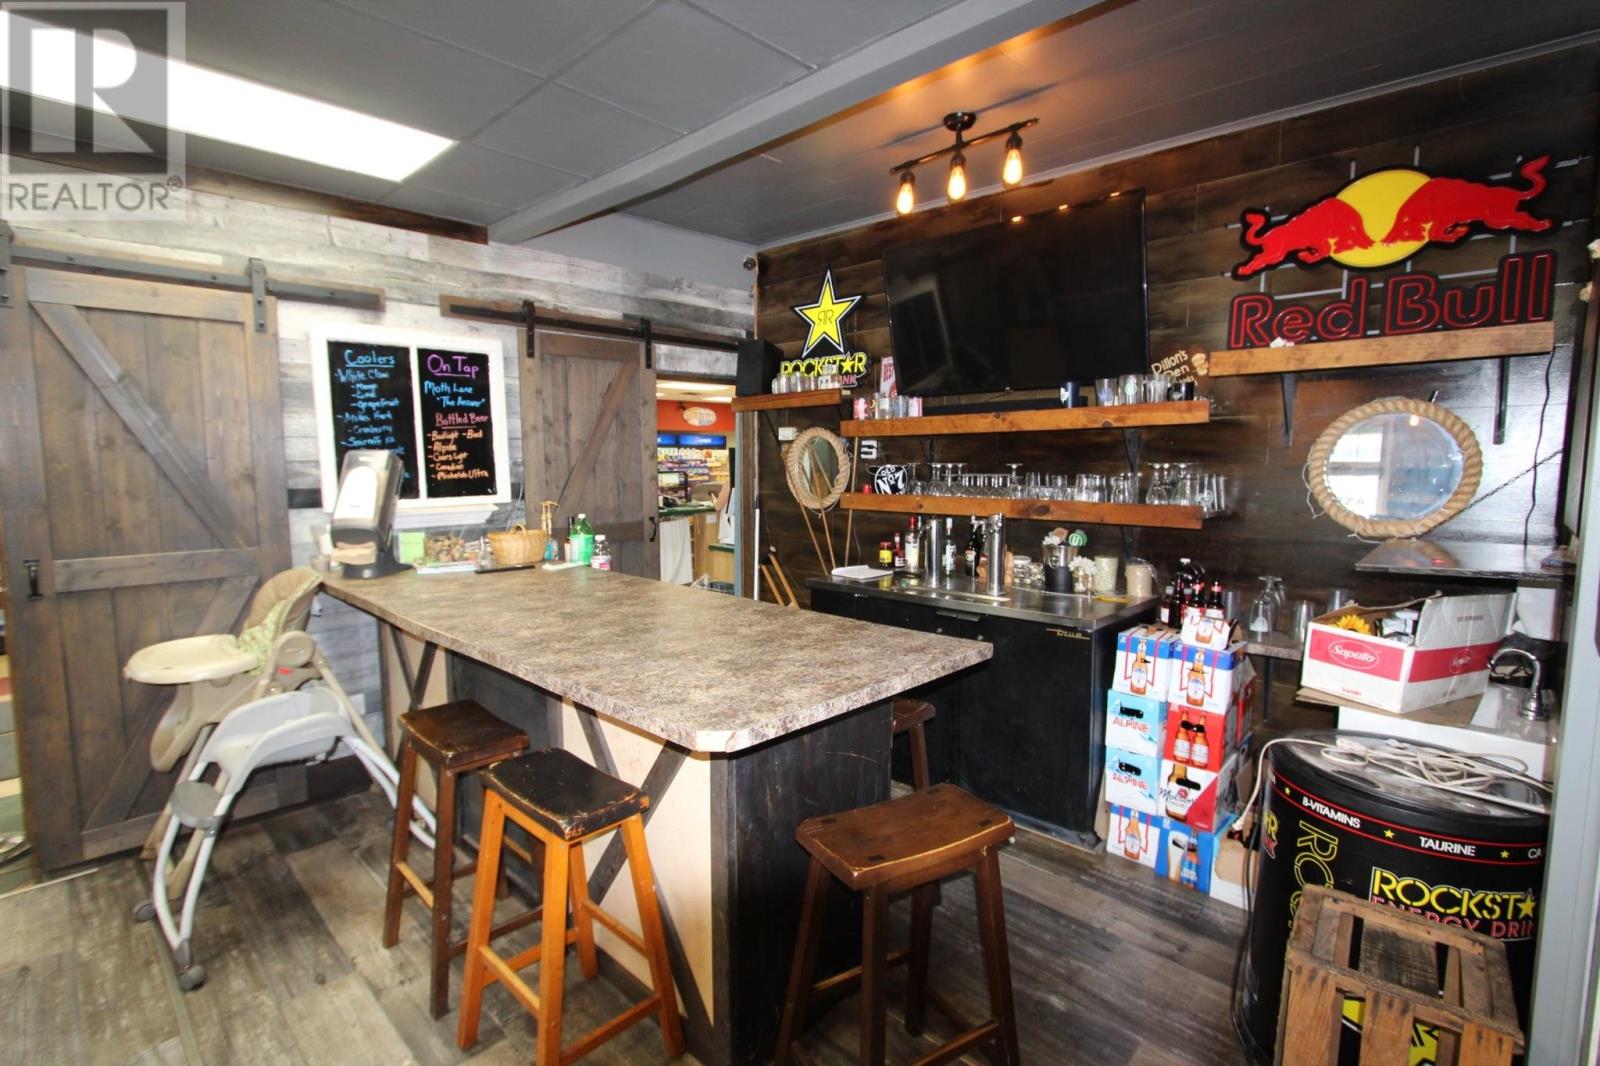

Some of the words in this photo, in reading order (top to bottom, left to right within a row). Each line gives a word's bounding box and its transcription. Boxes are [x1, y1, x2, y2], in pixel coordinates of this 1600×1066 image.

[1230, 276, 1370, 349] Red
[1384, 253, 1551, 336] Bull
[344, 349, 396, 366] Coolers
[427, 354, 451, 374] On
[452, 355, 480, 379] Tap
[453, 383, 473, 394] Lane
[1332, 645, 1377, 663] Saputo
[1112, 715, 1149, 733] ALPINE
[1302, 796, 1361, 829] B-VITAMINS
[1419, 836, 1476, 857] TAURINE
